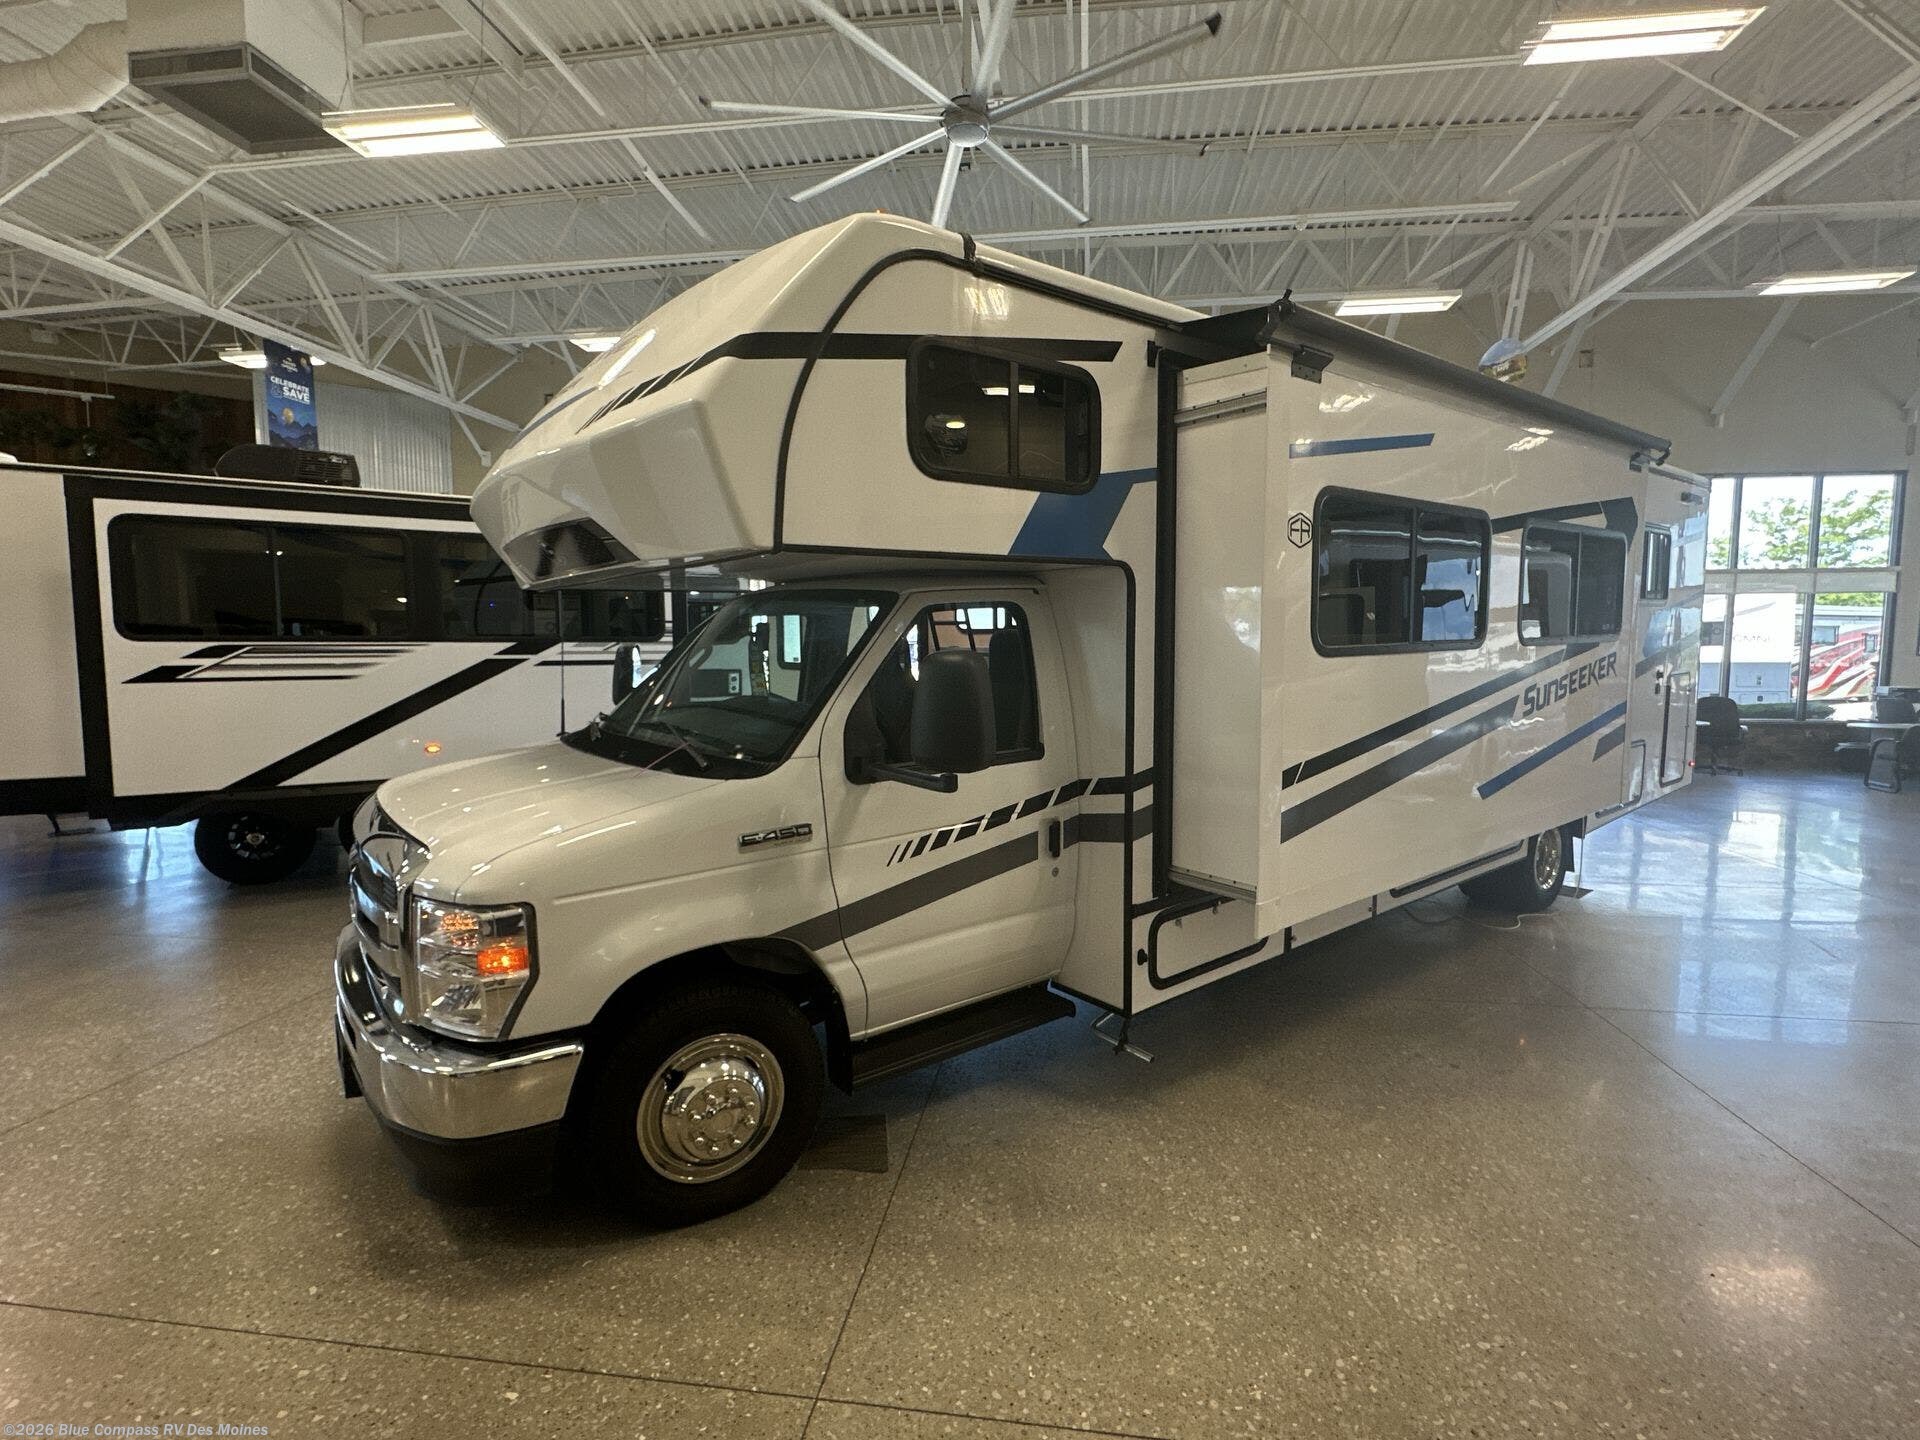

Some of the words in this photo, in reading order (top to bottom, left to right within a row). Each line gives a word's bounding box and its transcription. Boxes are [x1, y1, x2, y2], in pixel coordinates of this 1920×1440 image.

[270, 375, 310, 393] CELEBRATE
[282, 386, 310, 402] SAVE
[1522, 651, 1618, 718] SUNSEEKER
